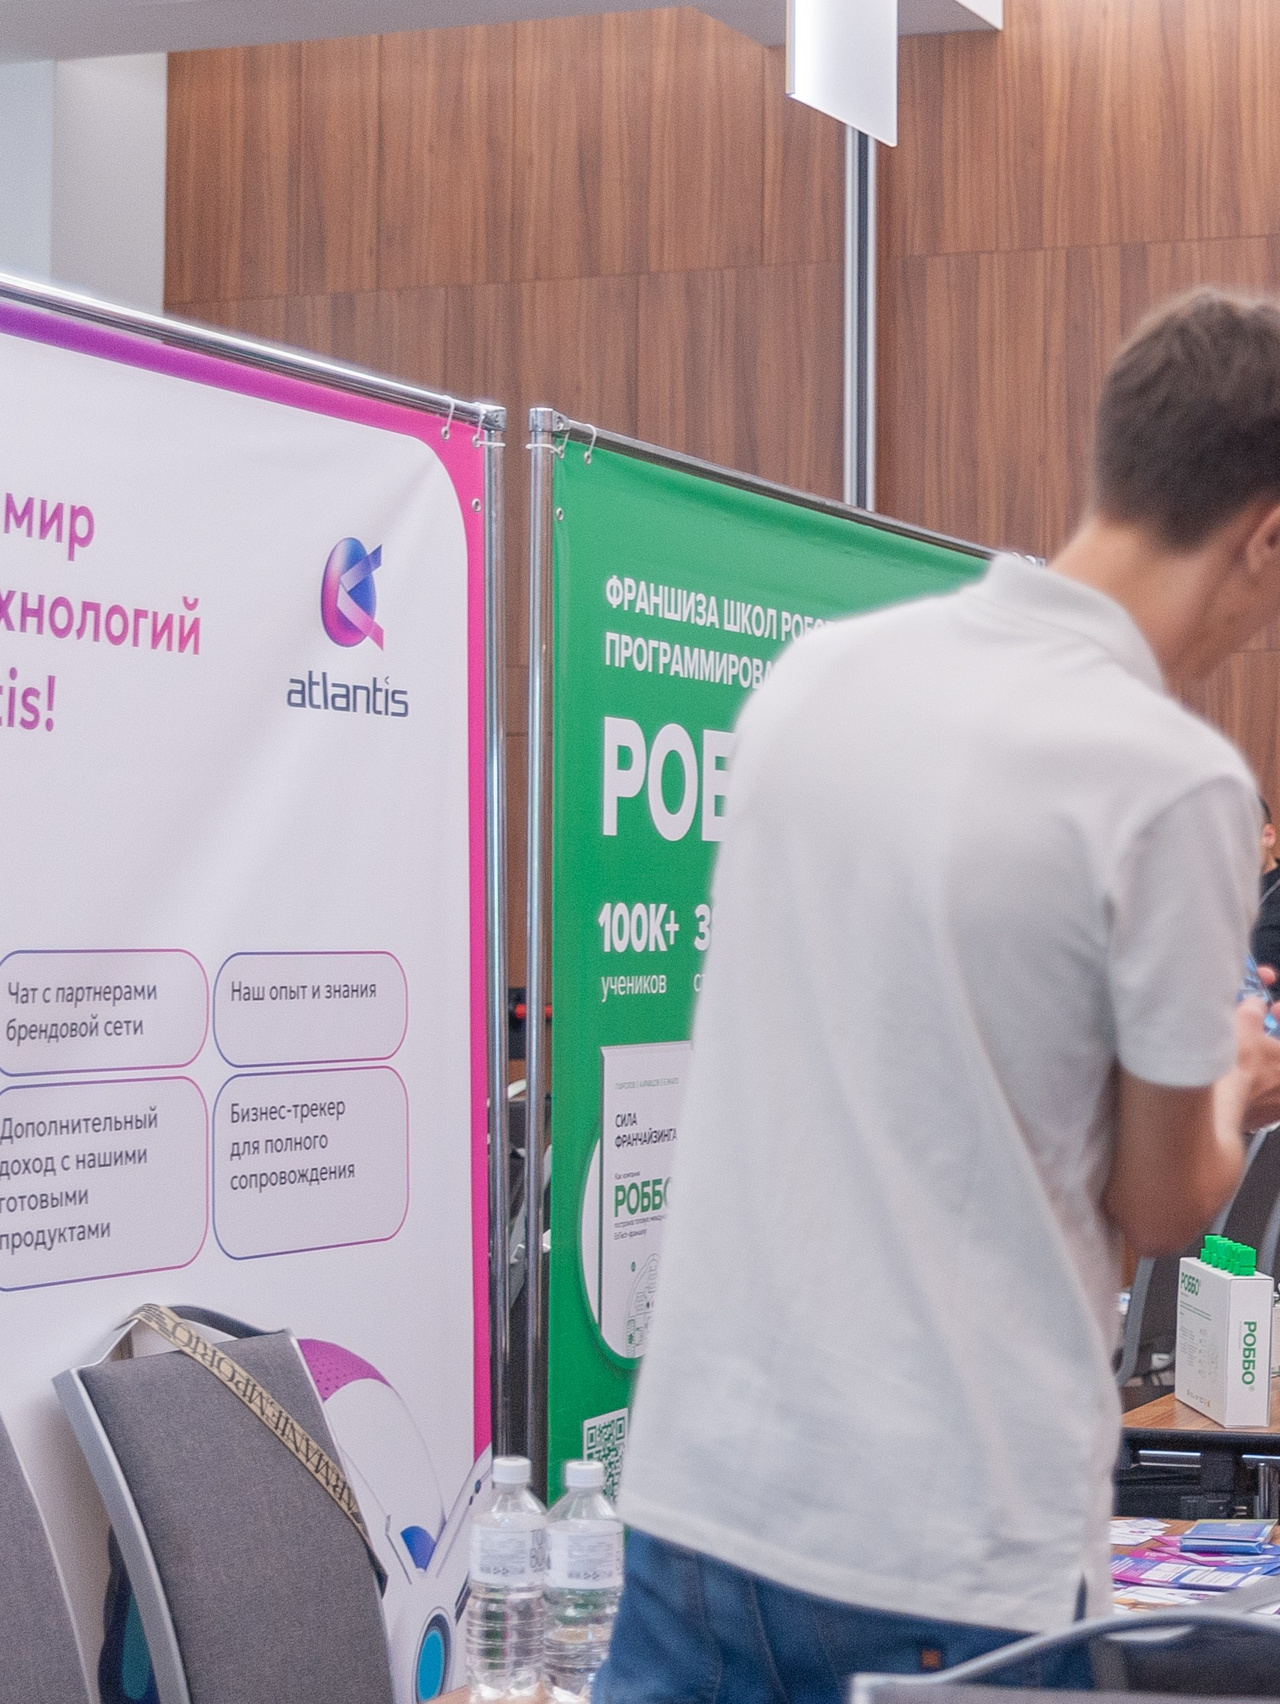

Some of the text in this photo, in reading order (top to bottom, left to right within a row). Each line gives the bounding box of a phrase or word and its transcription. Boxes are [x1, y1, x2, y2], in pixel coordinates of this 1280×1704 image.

[3, 492, 95, 561] мир
[605, 575, 720, 629] ФРАНШИЗА
[723, 599, 777, 640] ШКОЛ
[287, 670, 409, 718] atlantis
[8, 982, 158, 1008] Чат с партнерами
[231, 981, 377, 1001] Наш опыт и знания
[601, 975, 668, 1003] учеников
[6, 1014, 144, 1046] брендовой сети
[0, 1105, 158, 1145] Дополнительный
[231, 1099, 346, 1124] Бизнес-трекер
[615, 1112, 638, 1128] СИЛА
[230, 1131, 329, 1160] для полного
[614, 1128, 678, 1148] ФРАНЧАЙЗИНГА
[0, 1148, 148, 1181] доход с нашими
[230, 1161, 356, 1193] сопровождения
[0, 1189, 89, 1213] готовыми
[0, 1222, 111, 1255] продуктами
[1241, 1321, 1257, 1386] РОББО
